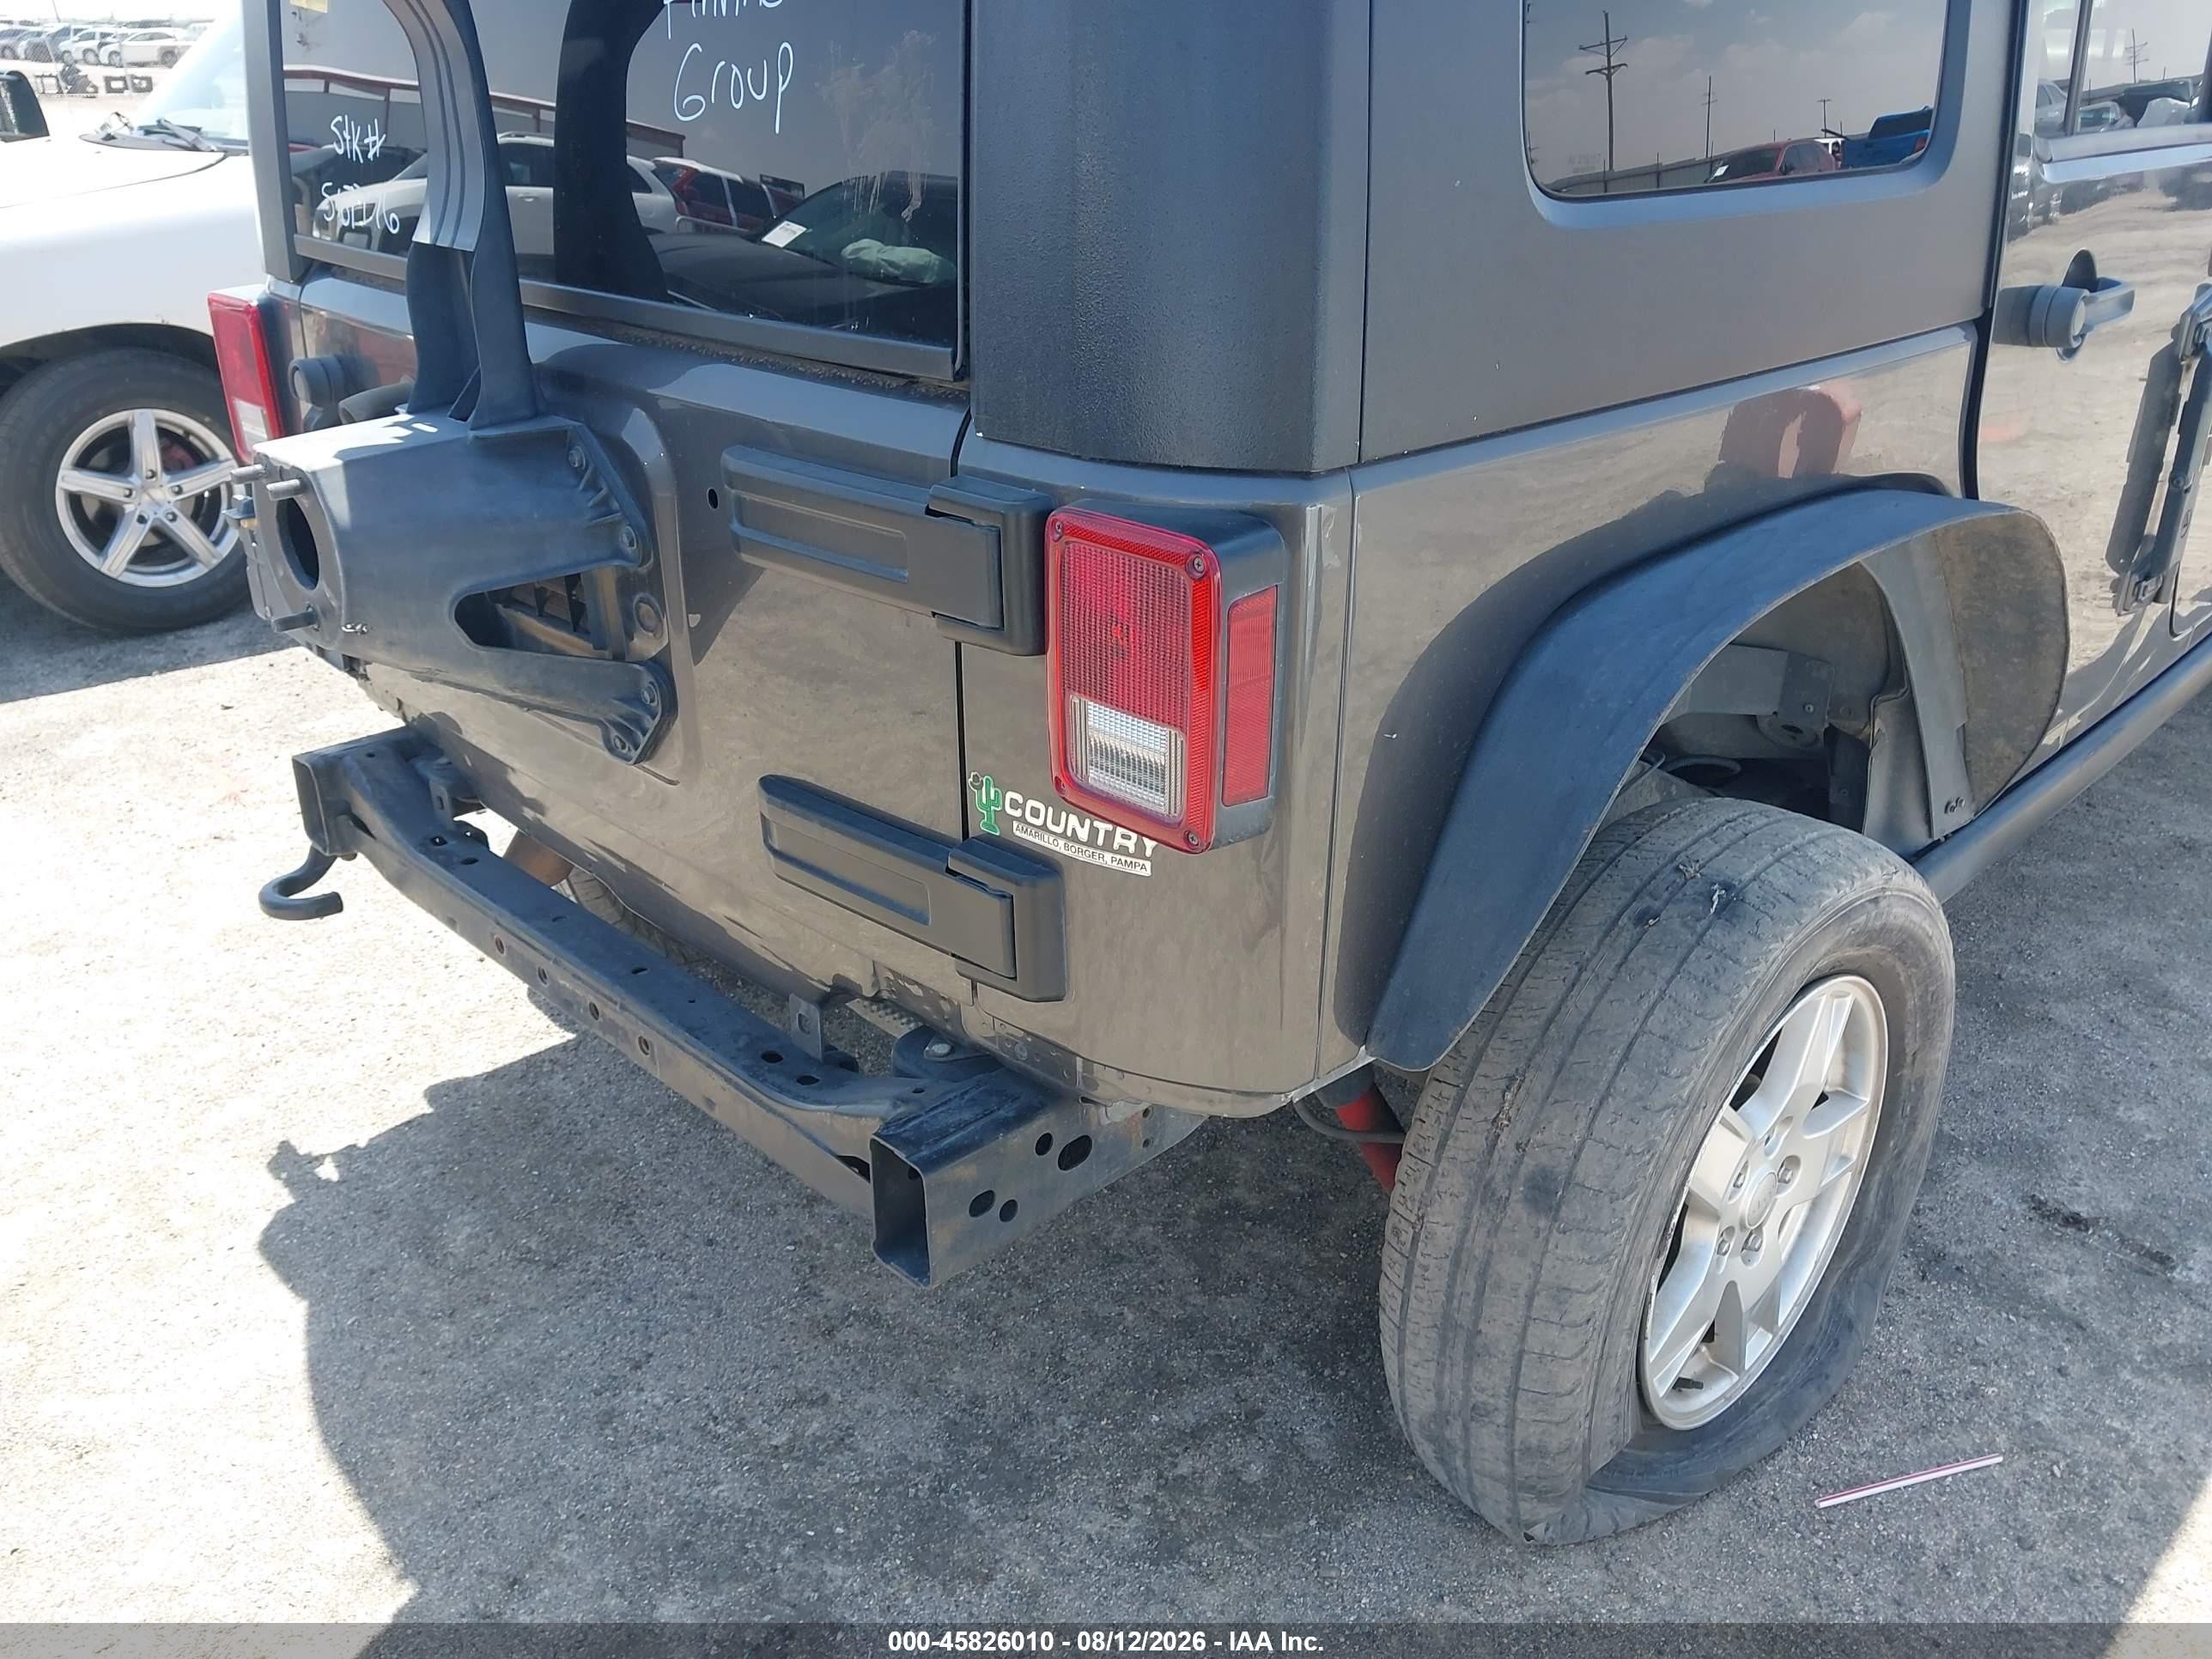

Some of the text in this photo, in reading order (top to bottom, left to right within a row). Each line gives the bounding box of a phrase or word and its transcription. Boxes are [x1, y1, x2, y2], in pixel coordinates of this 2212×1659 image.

[674, 41, 793, 135] Group
[1005, 791, 1158, 857] COUNTRY
[1015, 824, 1148, 872] AMARILLO, BORGER, PAMPA
